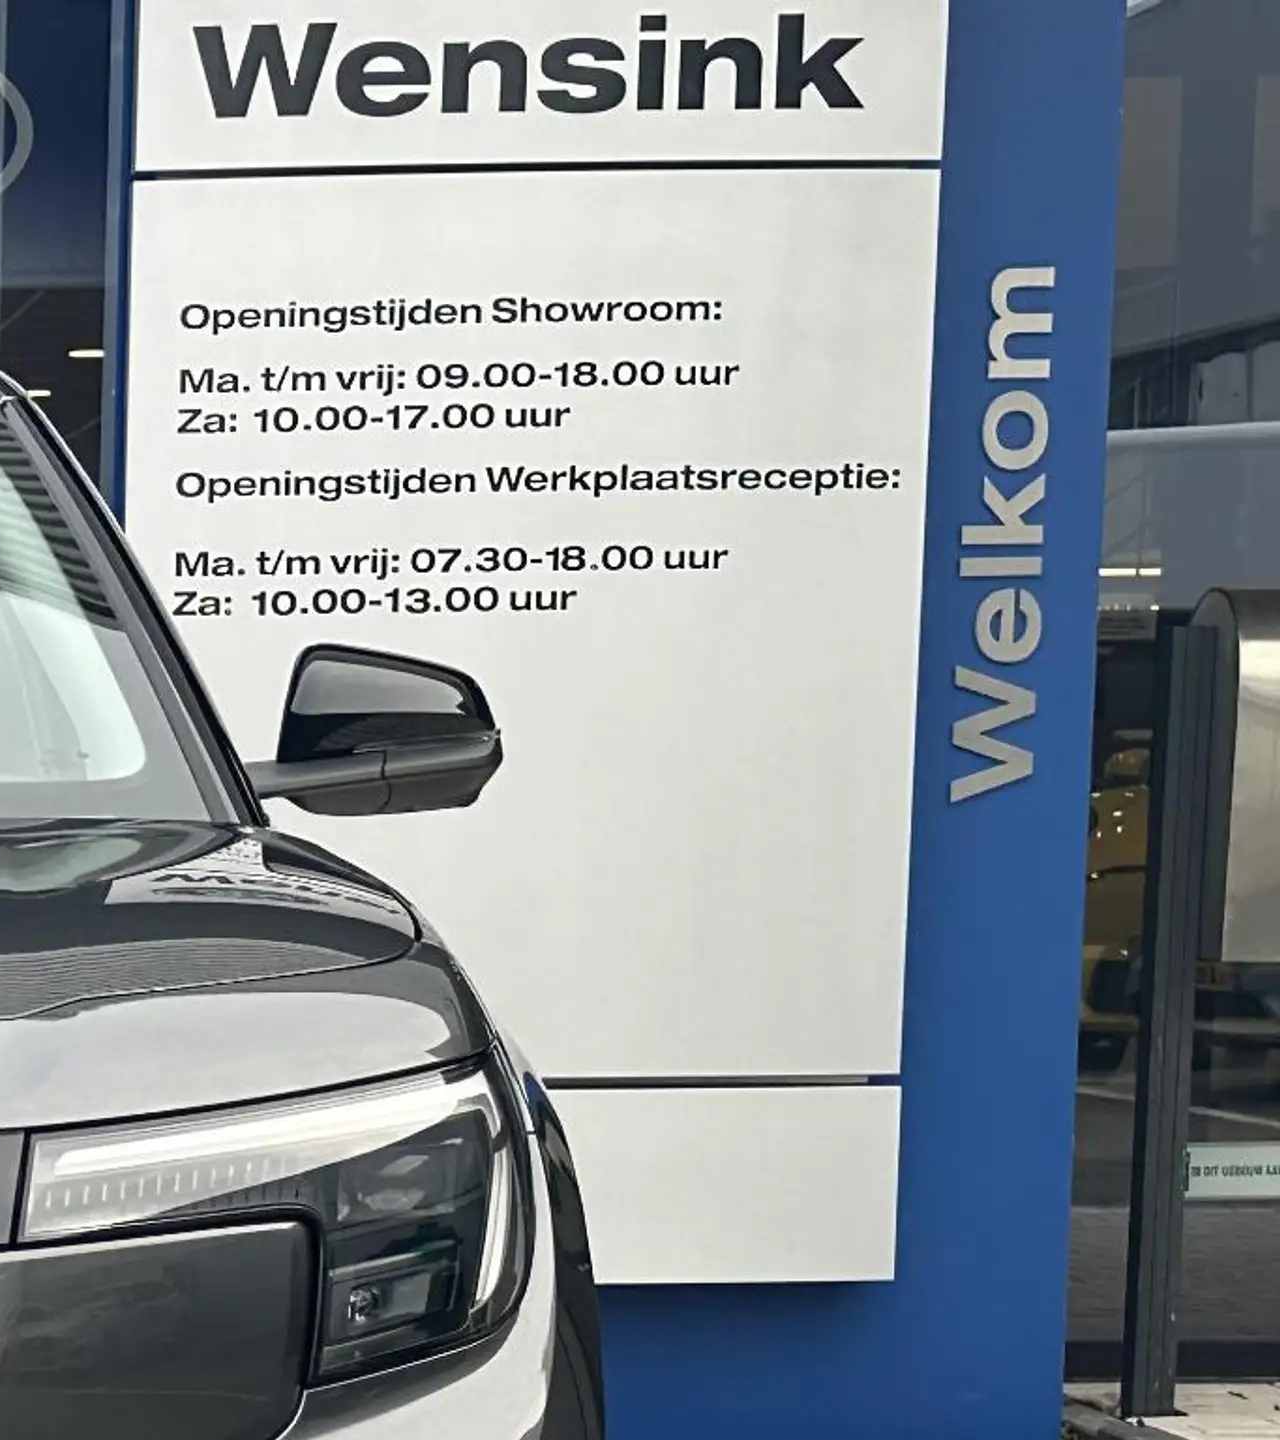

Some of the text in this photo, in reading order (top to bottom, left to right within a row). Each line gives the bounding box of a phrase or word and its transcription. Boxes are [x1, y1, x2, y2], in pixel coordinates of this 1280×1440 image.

[192, 13, 865, 118] Wensink
[180, 297, 724, 336] Openingstijden Showroom:
[178, 360, 740, 397] Ma. t/m vrij: 09.00-18.00 uur
[176, 403, 572, 434] Za: 10.00-17.00 uur
[176, 462, 902, 504] Openingstijden Werkplaatsreceptie:
[948, 265, 1057, 803] Welkom
[174, 545, 730, 581] Ma. t/m vrij: 07.30-18.00 uur
[172, 586, 578, 617] Za: 10.00-13.00 uur
